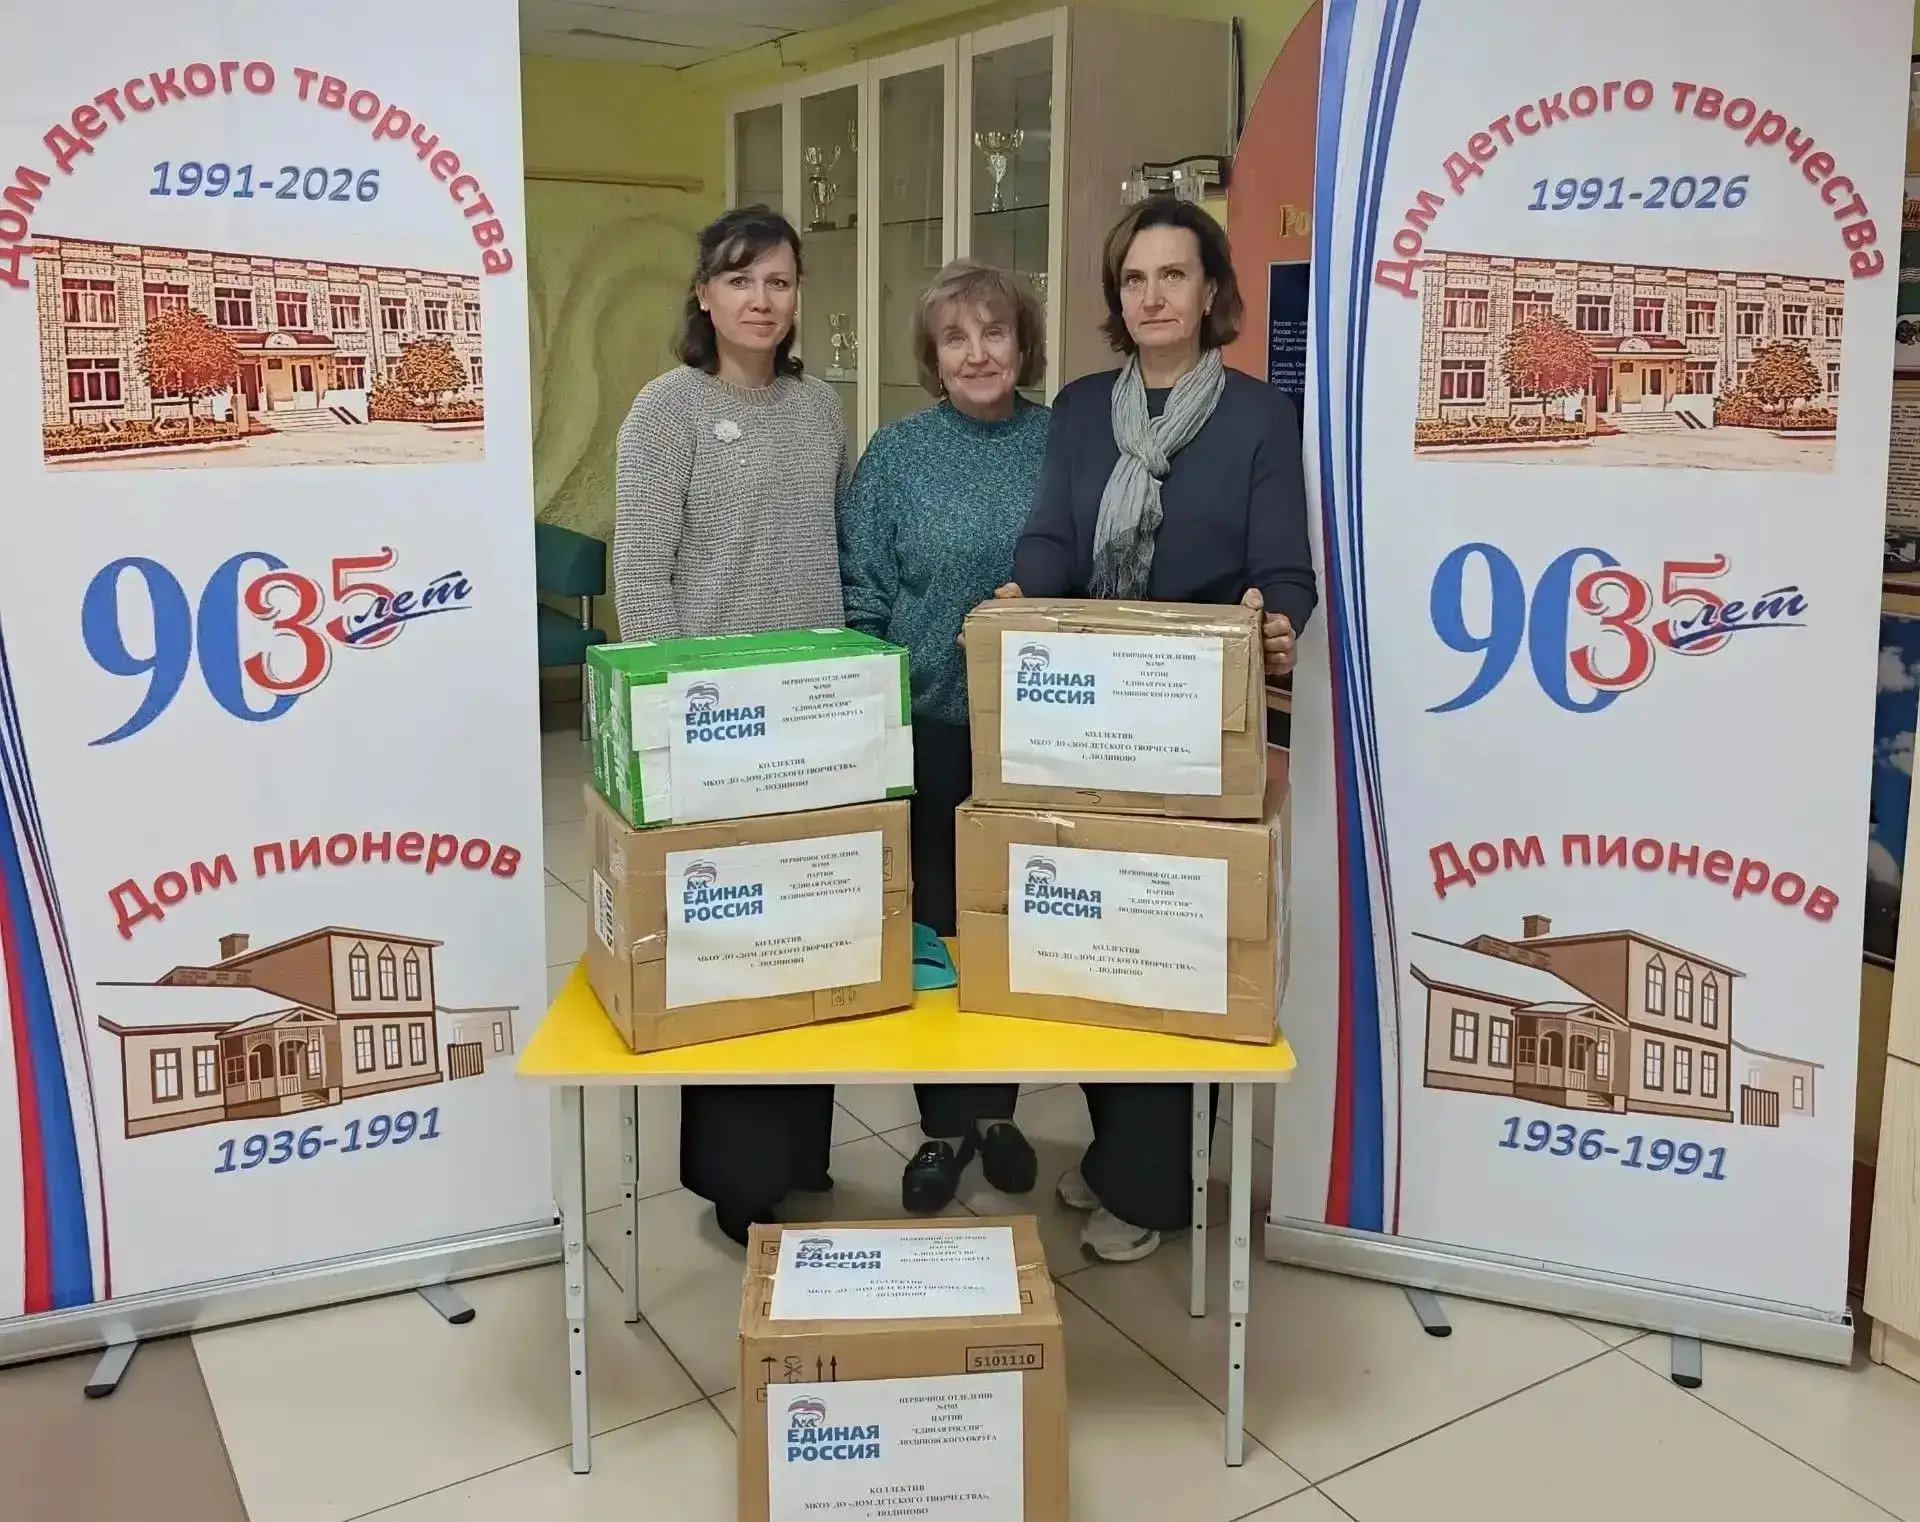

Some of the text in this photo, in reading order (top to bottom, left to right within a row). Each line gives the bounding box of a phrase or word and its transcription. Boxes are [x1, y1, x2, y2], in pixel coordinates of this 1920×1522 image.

[0, 61, 513, 289] Дом детского творчества
[149, 160, 381, 203] 1991-2026
[1374, 79, 1885, 299] Дом детского творчества
[1527, 174, 1749, 212] 1991-2026
[353, 570, 473, 626] лет
[1681, 585, 1808, 630] лет
[1017, 671, 1096, 688] ЕДИНАЯ
[1017, 688, 1096, 705] РОССИЯ
[685, 705, 766, 725] ЕДИНАЯ
[686, 722, 766, 744] РОССИЯ
[107, 830, 523, 939] Дом пионеров
[1429, 833, 1841, 923] Дом пионеров
[683, 883, 763, 905] ЕДИНАЯ
[1024, 882, 1102, 903] ЕДИНАЯ
[684, 899, 764, 923] РОССИЯ
[1024, 900, 1102, 919] РОССИЯ
[214, 1106, 442, 1175] 1936-1991
[1498, 1115, 1729, 1181] 1936-1991
[795, 1260, 882, 1270] РОССИЯ
[796, 1250, 882, 1260] ЕДИНАЯ
[788, 1424, 880, 1443] ЕДИНАЯ
[788, 1443, 880, 1462] РОССИЯ
